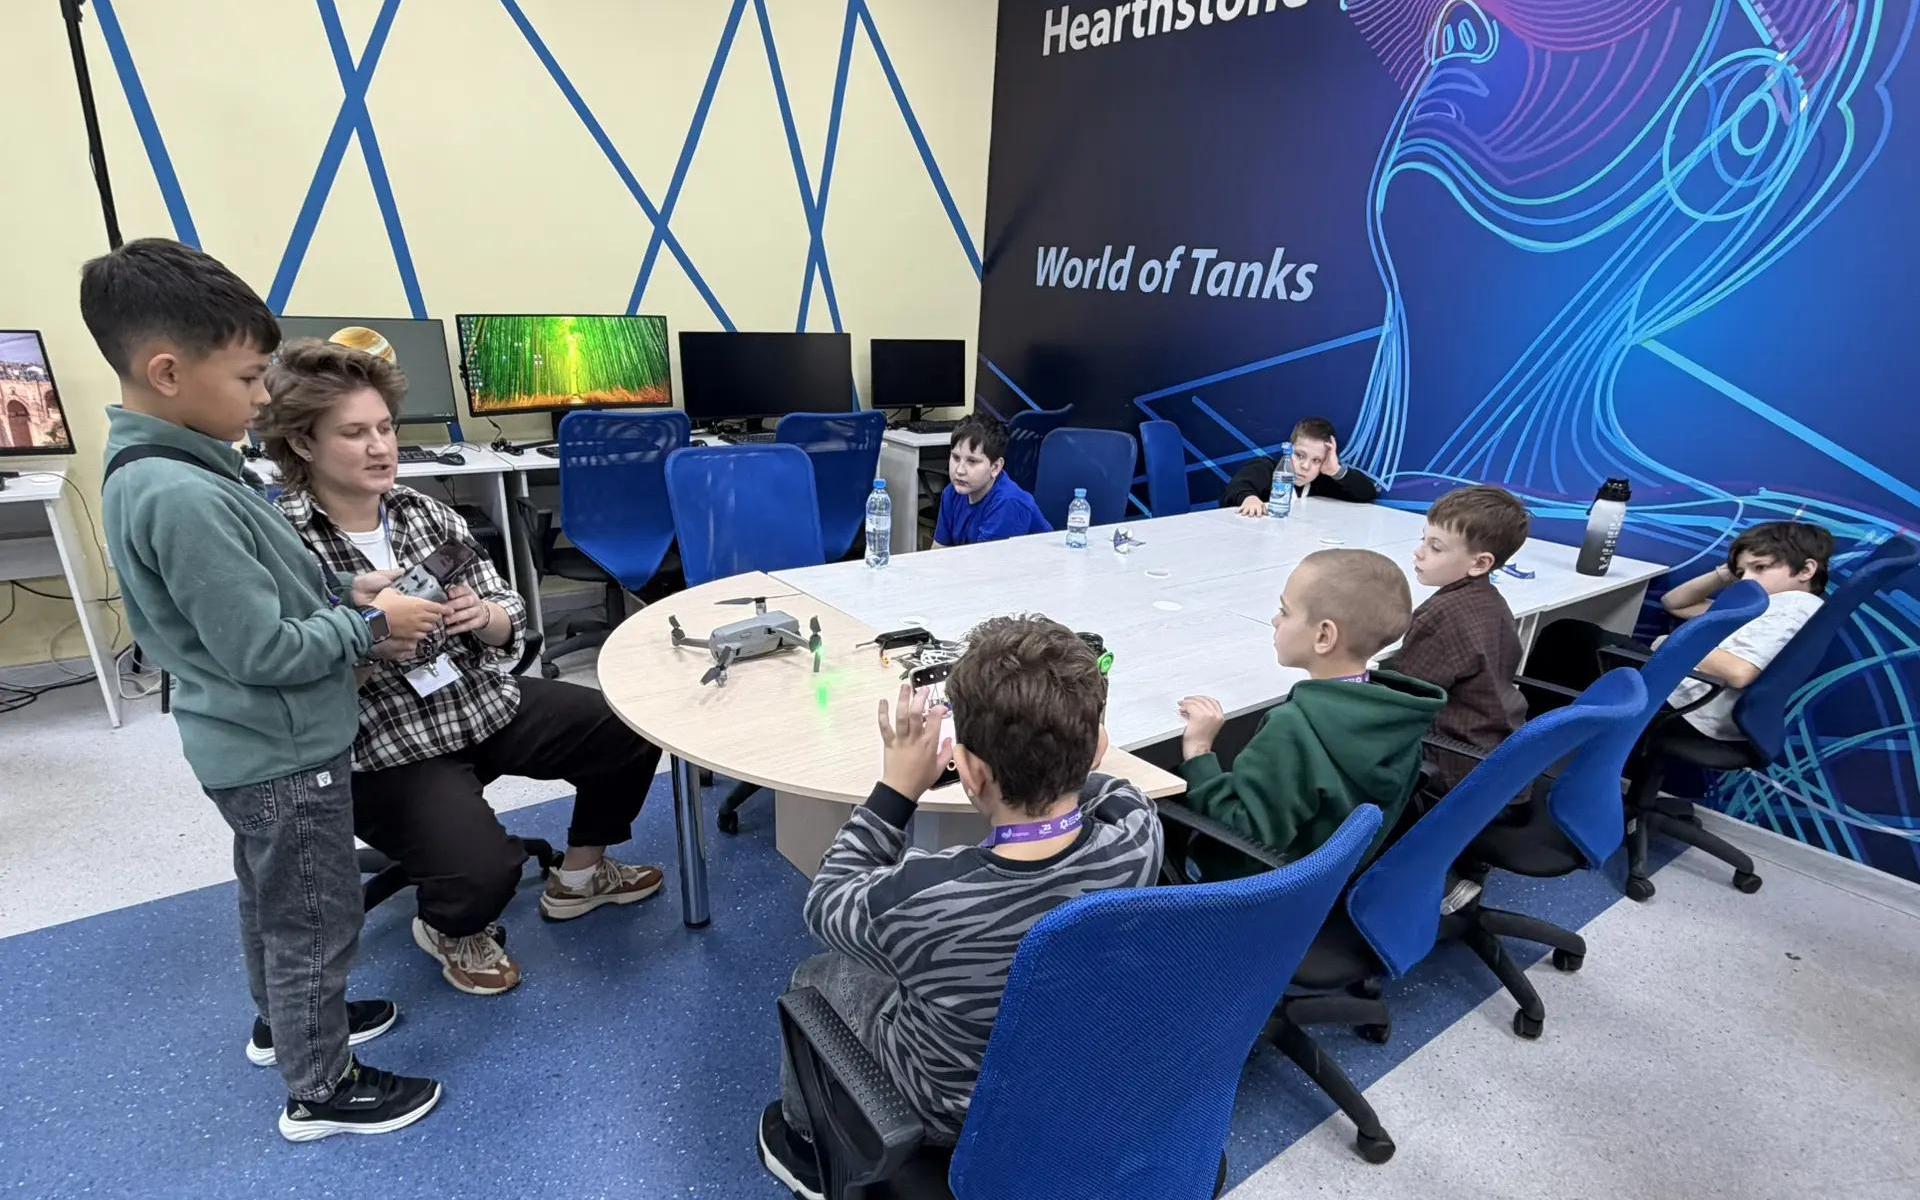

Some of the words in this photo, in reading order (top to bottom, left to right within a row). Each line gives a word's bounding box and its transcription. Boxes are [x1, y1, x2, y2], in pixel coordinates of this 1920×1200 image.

[1043, 0, 1308, 56] Hearthsto
[1036, 245, 1135, 291] World
[1138, 246, 1185, 293] of
[1190, 247, 1318, 301] Tanks
